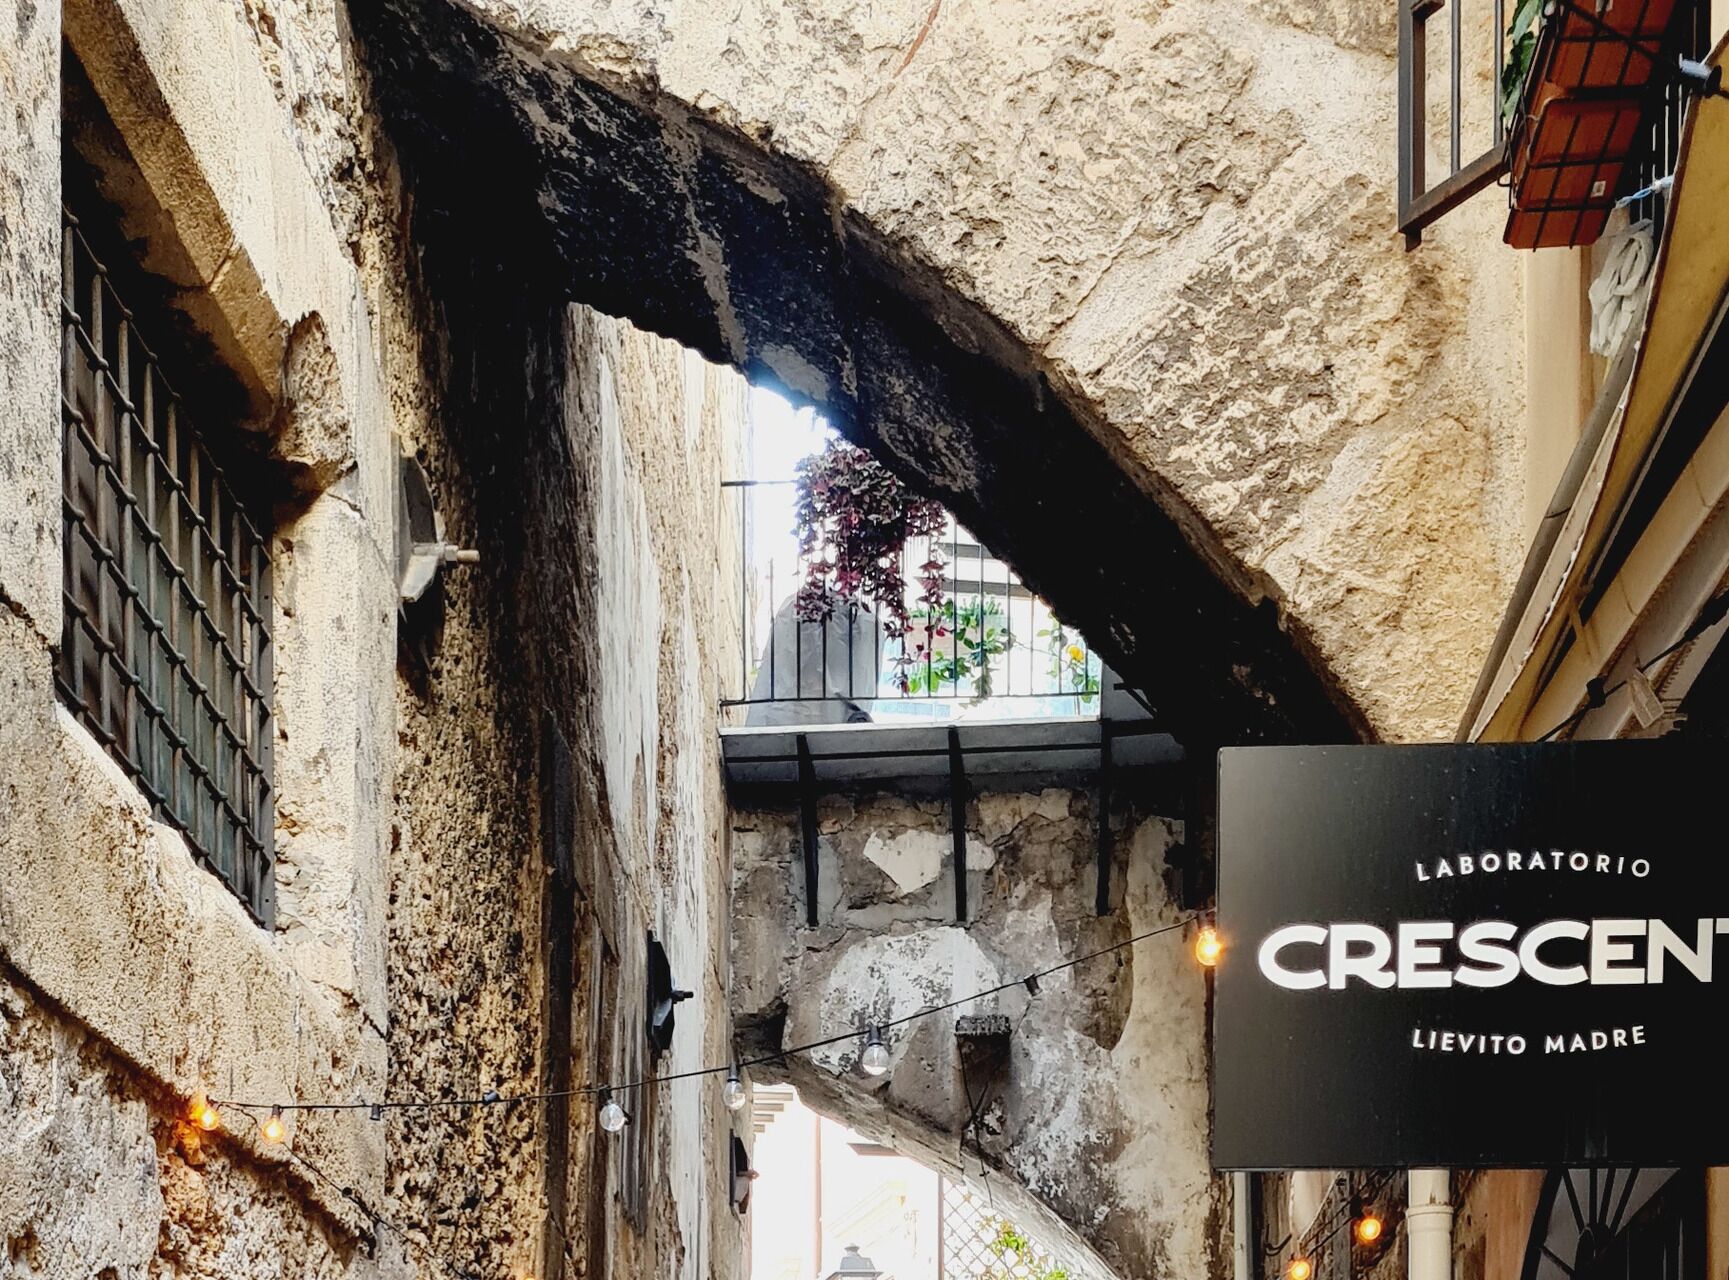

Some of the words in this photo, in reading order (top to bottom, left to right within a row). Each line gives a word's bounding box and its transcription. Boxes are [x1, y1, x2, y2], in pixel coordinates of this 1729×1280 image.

[1416, 851, 1650, 882] LABORATORIO
[1257, 917, 1729, 990] CRESCEN
[1412, 1028, 1526, 1055] LIEVITO
[1545, 1025, 1646, 1054] MADRE
